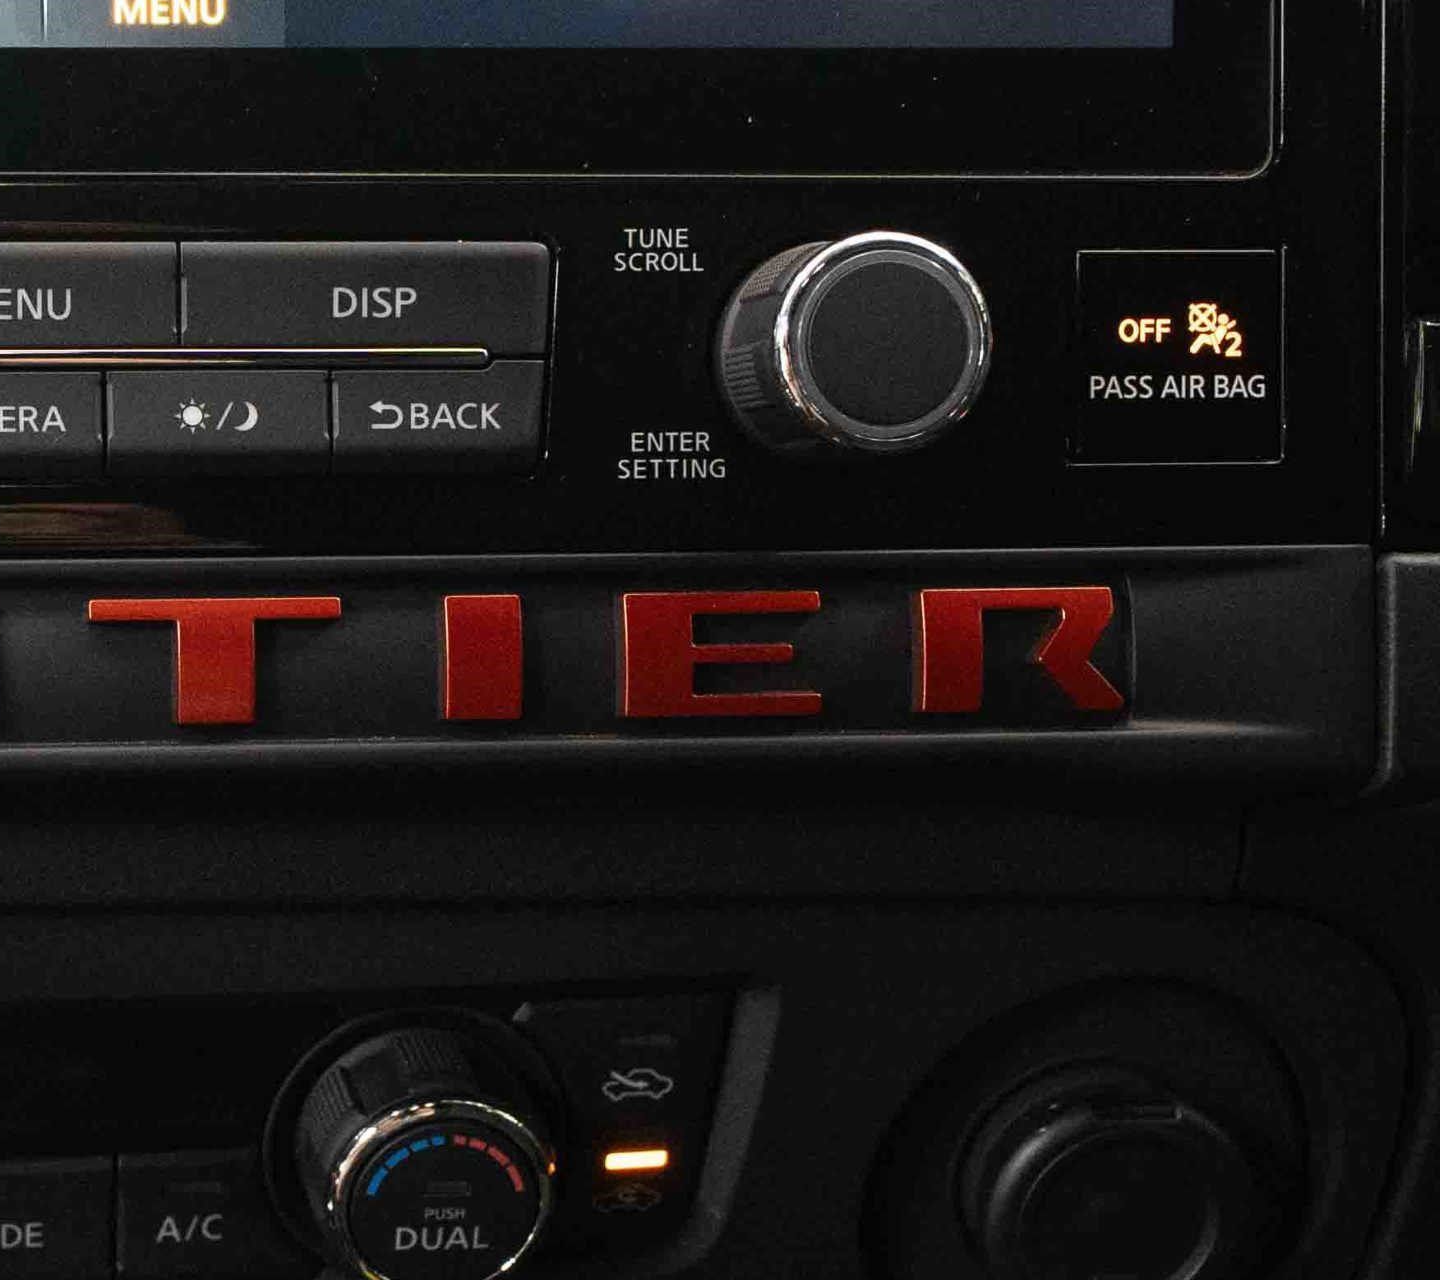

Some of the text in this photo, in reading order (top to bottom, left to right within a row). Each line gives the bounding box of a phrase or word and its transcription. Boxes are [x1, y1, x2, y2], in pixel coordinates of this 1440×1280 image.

[624, 228, 689, 250] TUNE
[613, 251, 704, 273] SCROLL
[332, 286, 418, 319] DISP
[1118, 318, 1172, 343] OFF
[1090, 373, 1266, 400] PASS AIR BAG
[409, 402, 502, 431] BACK
[630, 431, 710, 453] ENTER
[617, 458, 726, 480] SETTING
[423, 1206, 467, 1221] PUSH
[155, 1214, 224, 1244] A/C
[394, 1225, 489, 1253] DUAL
